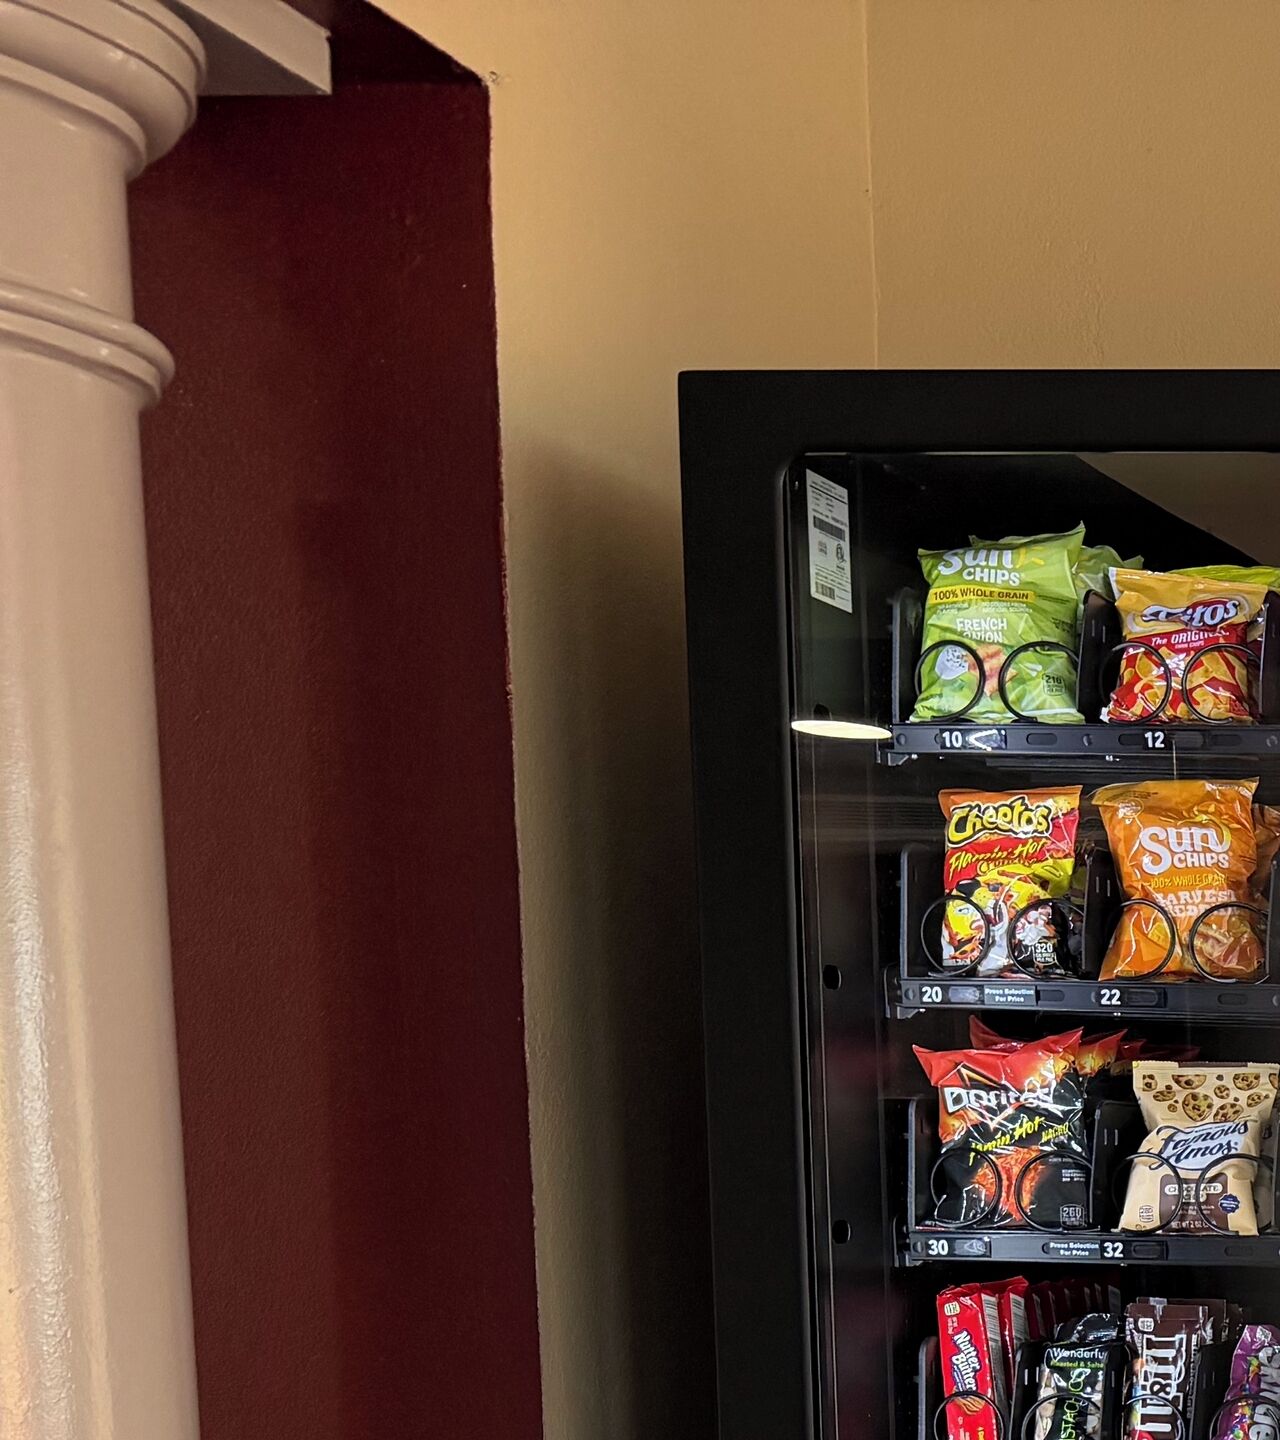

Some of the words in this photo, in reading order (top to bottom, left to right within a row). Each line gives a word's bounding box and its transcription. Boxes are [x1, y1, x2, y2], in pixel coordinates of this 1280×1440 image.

[962, 567, 1021, 587] CHIPS
[933, 589, 959, 601] 100%
[960, 587, 995, 598] WHOLE
[997, 591, 1029, 600] GRAIN
[956, 617, 1007, 632] FRENCH
[963, 631, 1003, 643] ONION
[943, 732, 962, 747] 10
[1145, 732, 1164, 747] 12
[948, 797, 1051, 844] Cheetos
[1140, 826, 1223, 876] Sun
[1173, 852, 1230, 869] CHIPS
[1174, 875, 1201, 886] WHOLE
[922, 987, 942, 1002] 20
[1101, 989, 1120, 1004] 22
[943, 1087, 1054, 1114] Doritos
[1167, 1140, 1240, 1165] Amos
[929, 1240, 948, 1255] 30
[1104, 1242, 1123, 1257] 32
[953, 1330, 981, 1372] Nutter
[952, 1353, 978, 1391] Butter
